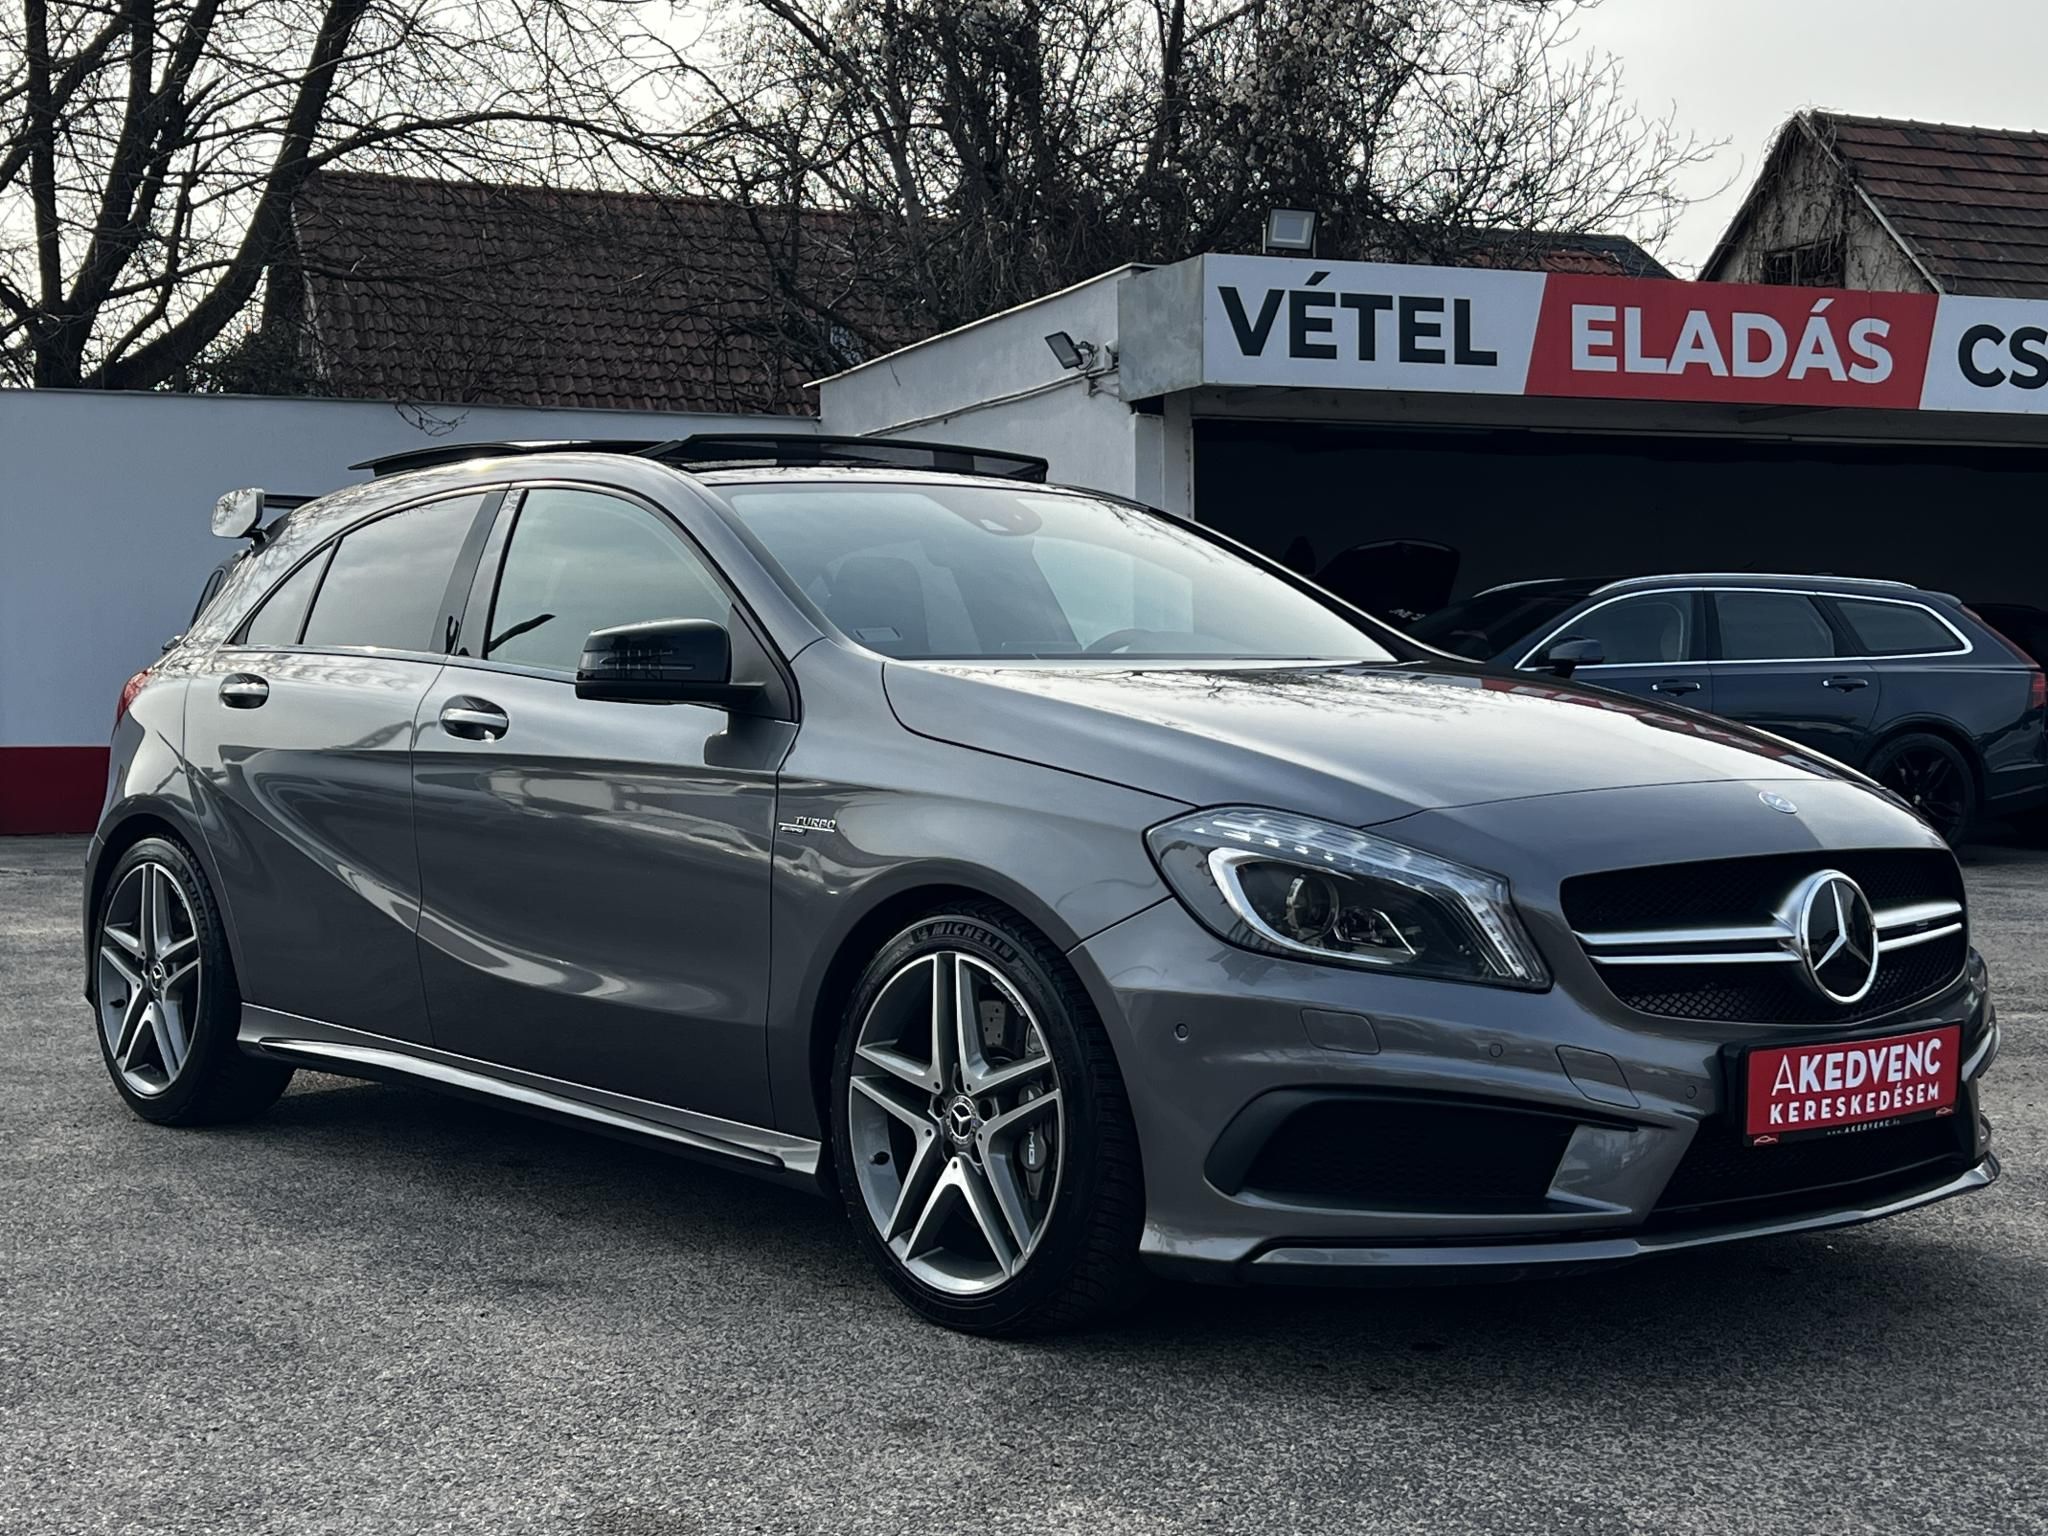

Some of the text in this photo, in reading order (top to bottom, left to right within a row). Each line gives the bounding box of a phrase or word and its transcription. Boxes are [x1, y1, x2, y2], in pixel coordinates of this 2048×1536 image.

[1218, 272, 2048, 389] VÉTEL ELADÁS CS
[931, 922, 1014, 960] MICHELIN
[1769, 1081, 1940, 1125] KERESKEDÉSEM
